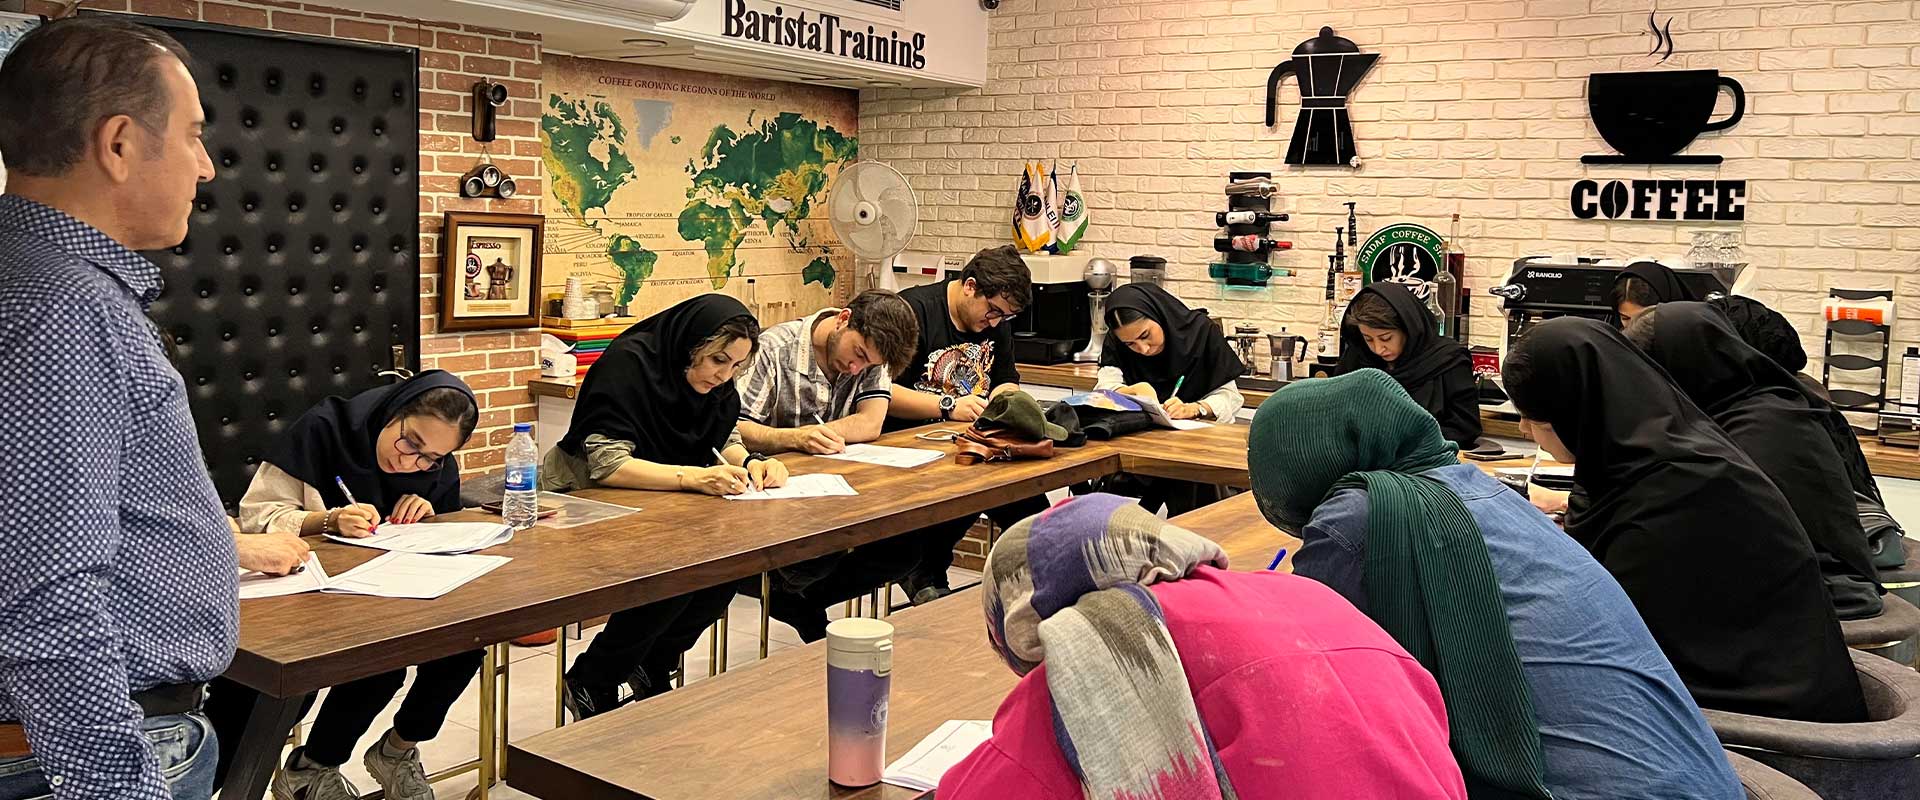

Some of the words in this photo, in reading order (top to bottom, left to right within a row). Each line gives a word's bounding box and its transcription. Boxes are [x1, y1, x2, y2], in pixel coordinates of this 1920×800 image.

[598, 75, 633, 87] COFFEE
[634, 79, 680, 92] GROWING
[680, 84, 718, 96] REGIONS
[718, 88, 729, 96] OF
[729, 89, 747, 98] THE
[747, 91, 776, 101] WORLD
[1570, 179, 1746, 221] COFFEE
[472, 240, 502, 250] ESPRESSO
[1361, 235, 1387, 263] SADAF
[1391, 230, 1431, 244] COFFEE
